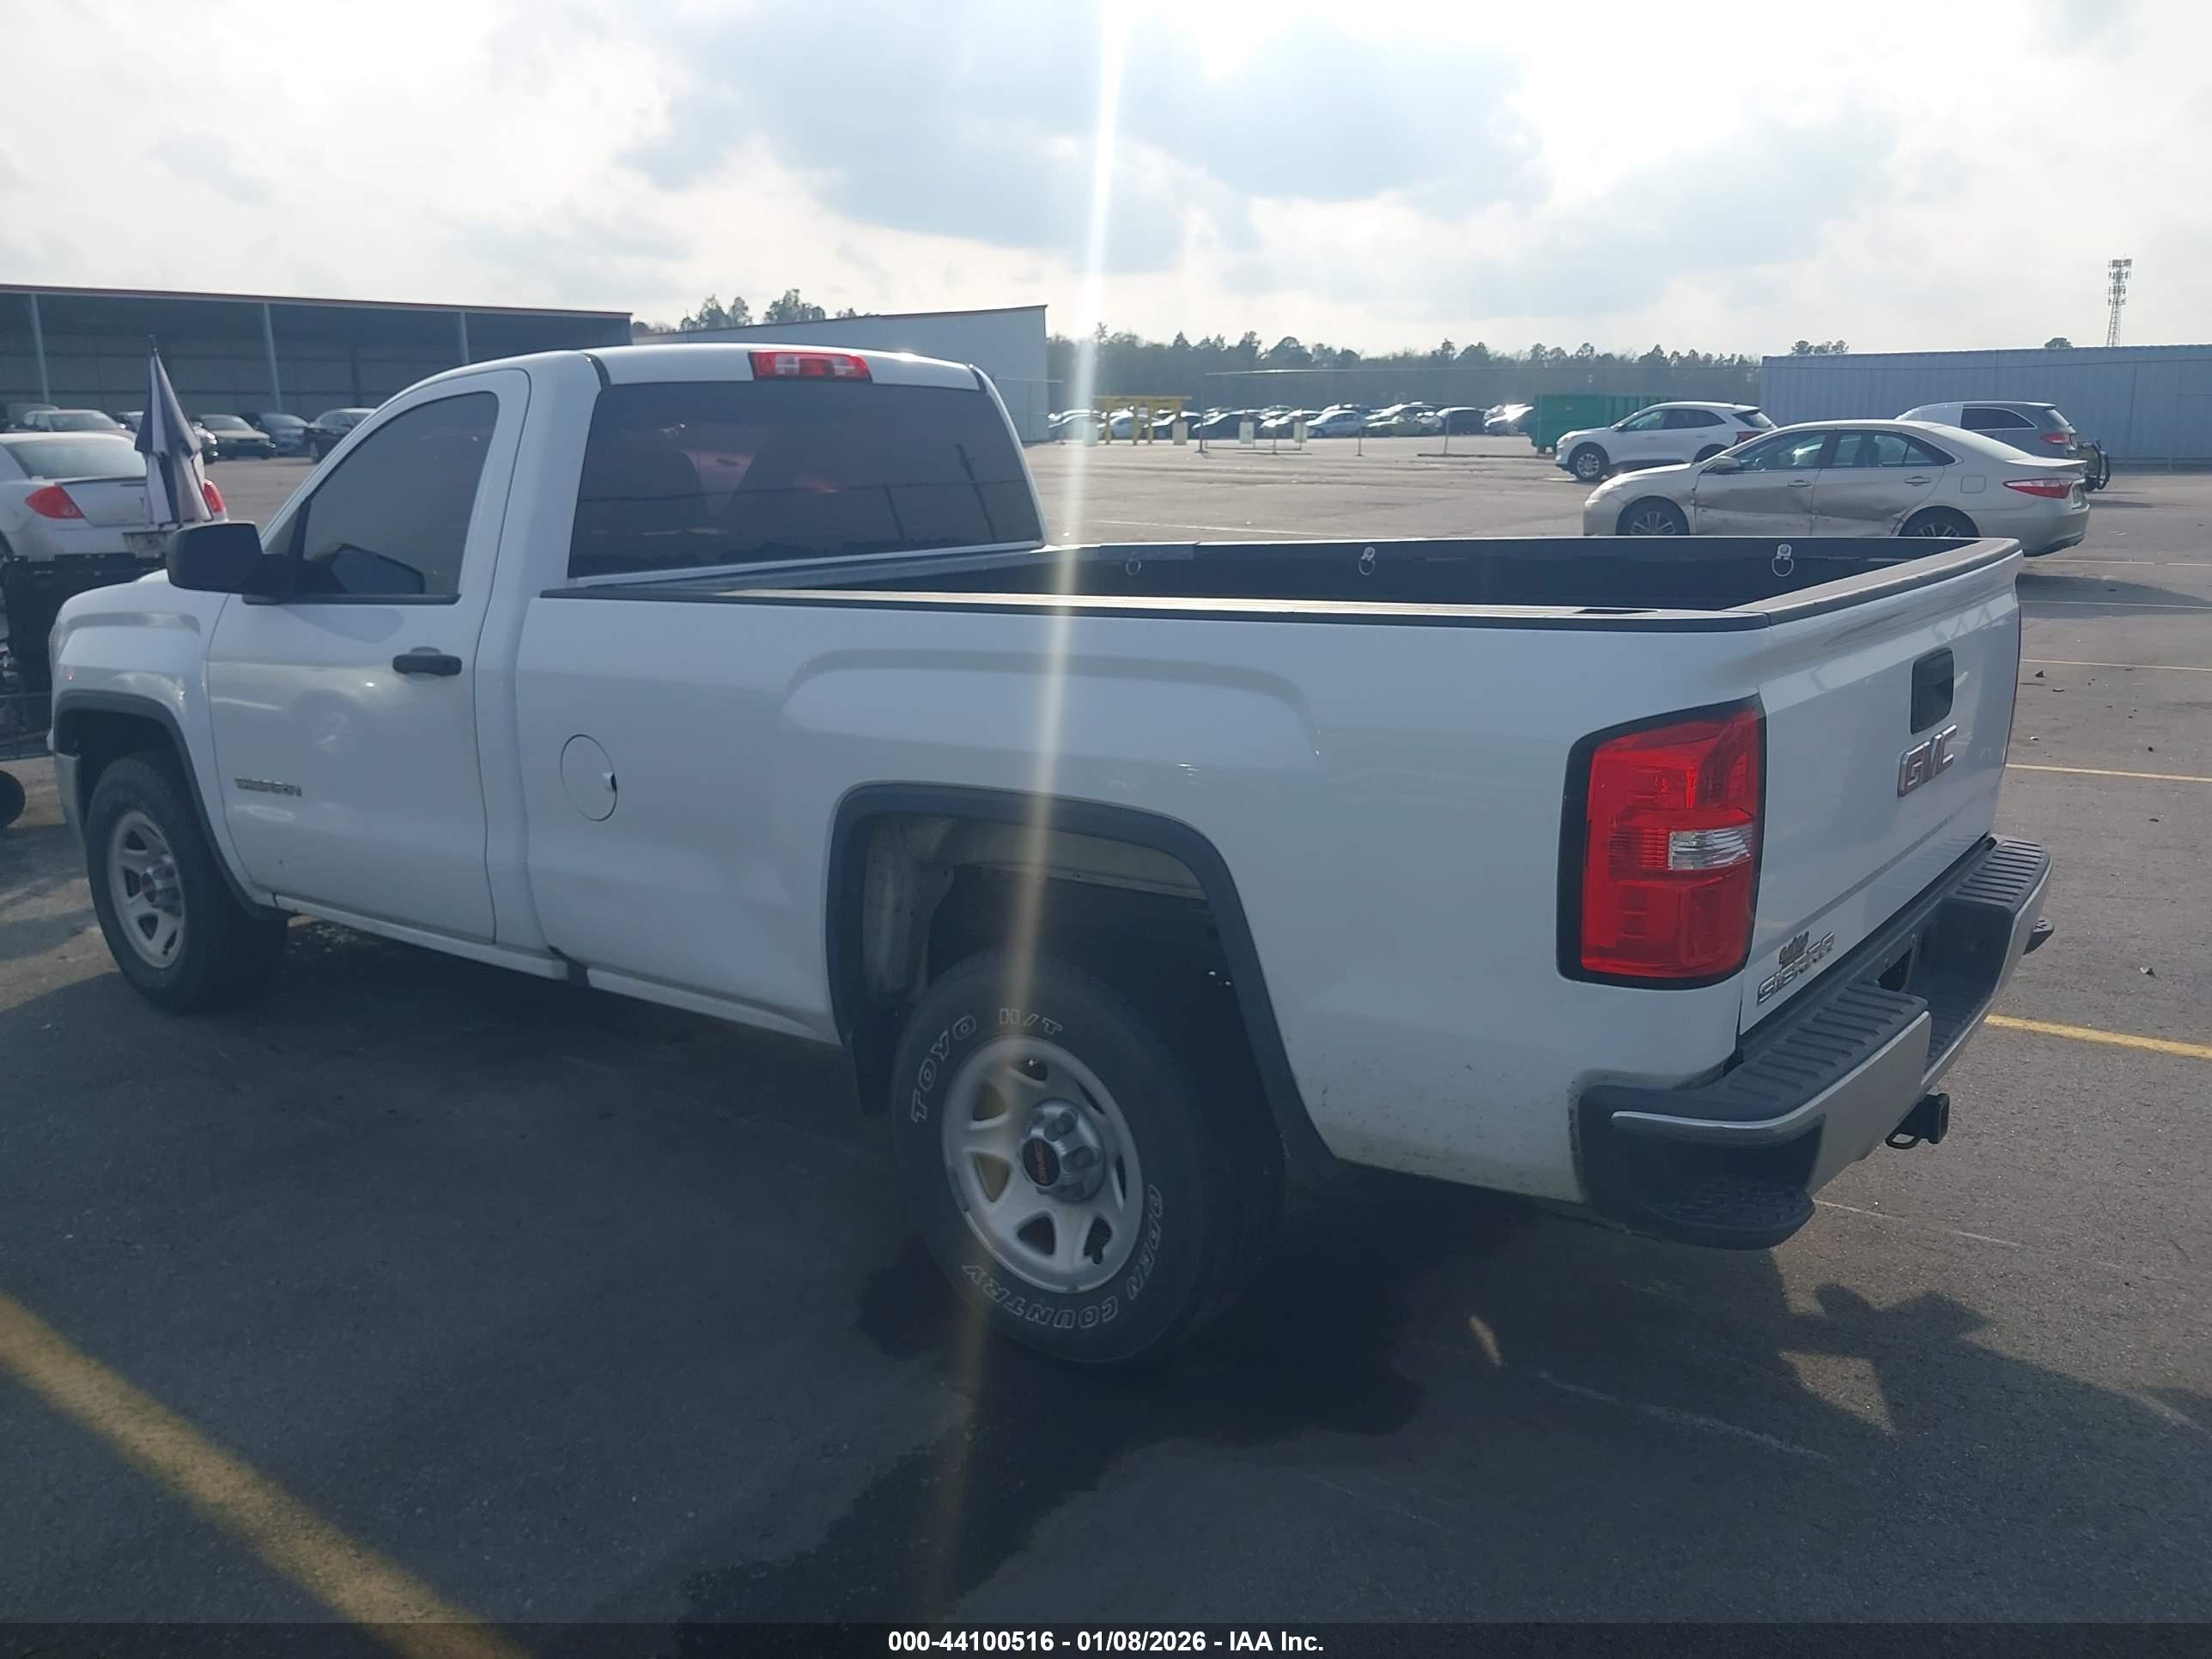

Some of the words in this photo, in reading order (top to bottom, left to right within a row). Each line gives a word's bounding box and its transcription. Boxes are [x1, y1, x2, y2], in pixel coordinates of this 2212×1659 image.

[1897, 724, 1958, 798] GMC
[910, 1015, 977, 1123] TOYO
[999, 1008, 1064, 1036] H/T
[1124, 1183, 1164, 1301] OPEN
[962, 1264, 1119, 1329] COUNTRY
